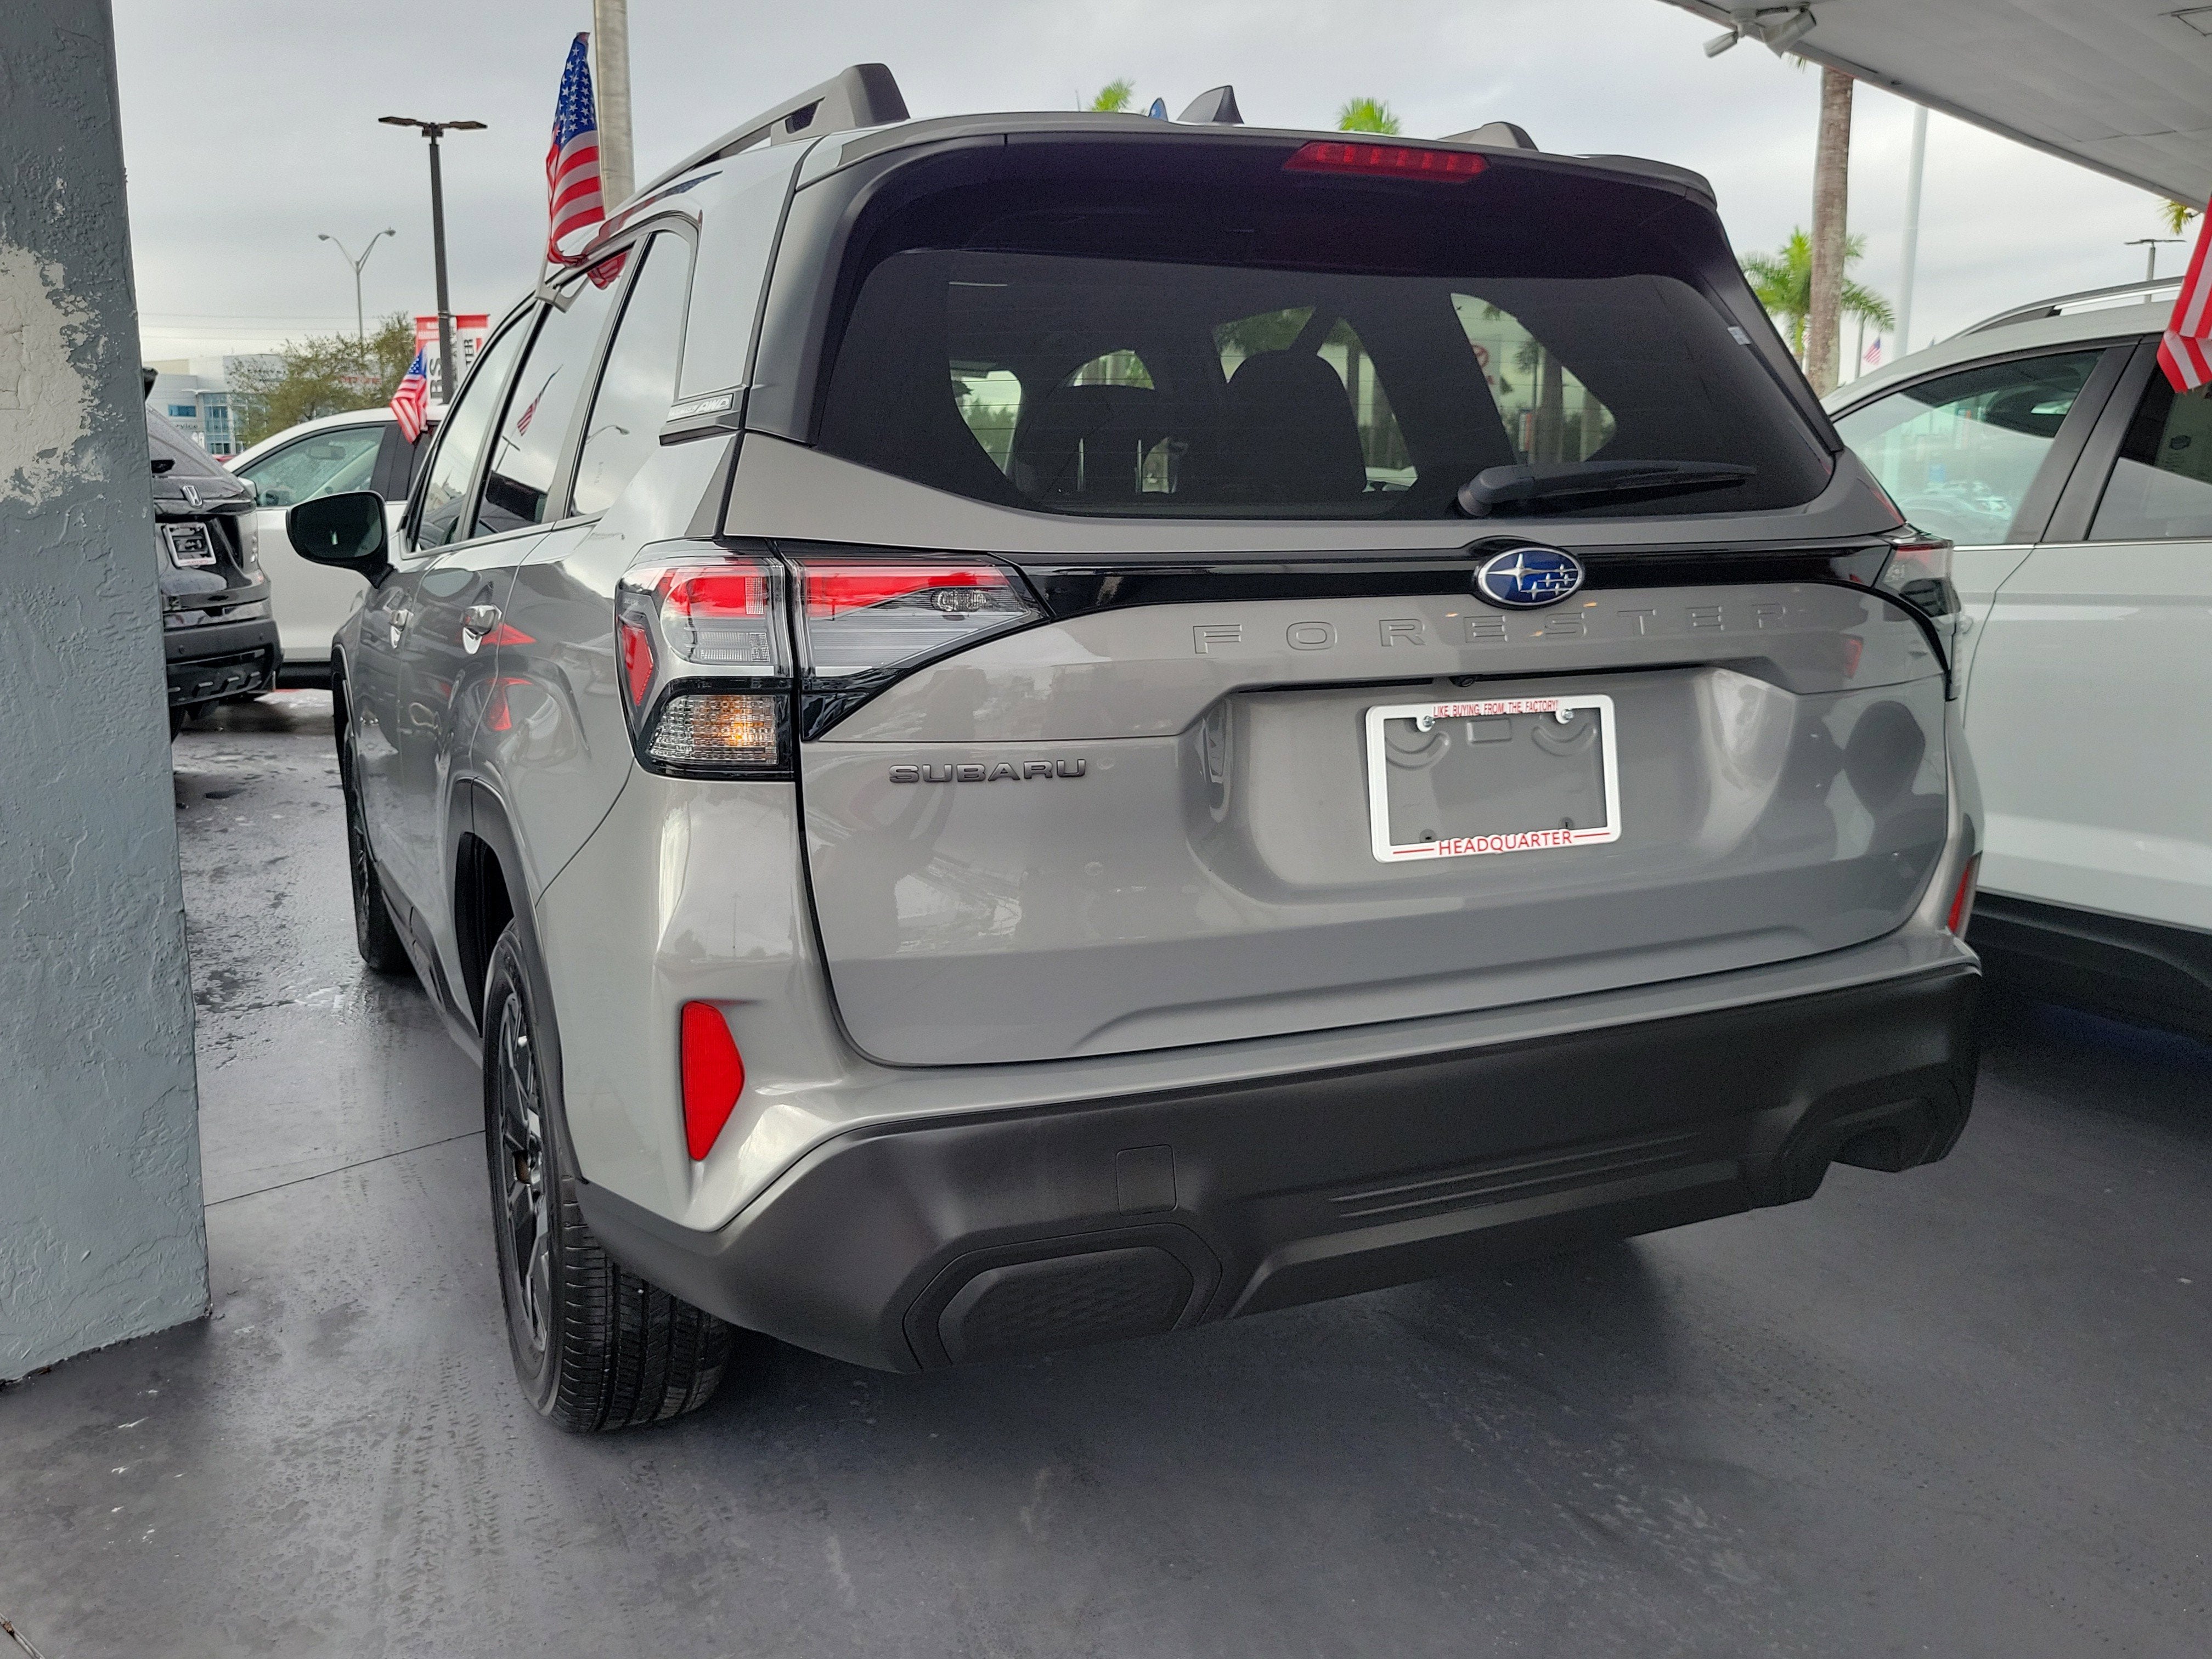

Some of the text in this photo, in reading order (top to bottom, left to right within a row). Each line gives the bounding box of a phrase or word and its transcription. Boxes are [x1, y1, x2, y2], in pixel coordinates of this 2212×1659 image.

[695, 398, 730, 414] AWD
[1193, 603, 1790, 654] FORESTER
[1433, 699, 1558, 717] LIKE BUYING FROM THE FACTORY!
[889, 759, 1086, 783] SUBARU
[1438, 831, 1572, 855] HEADQUARTER
